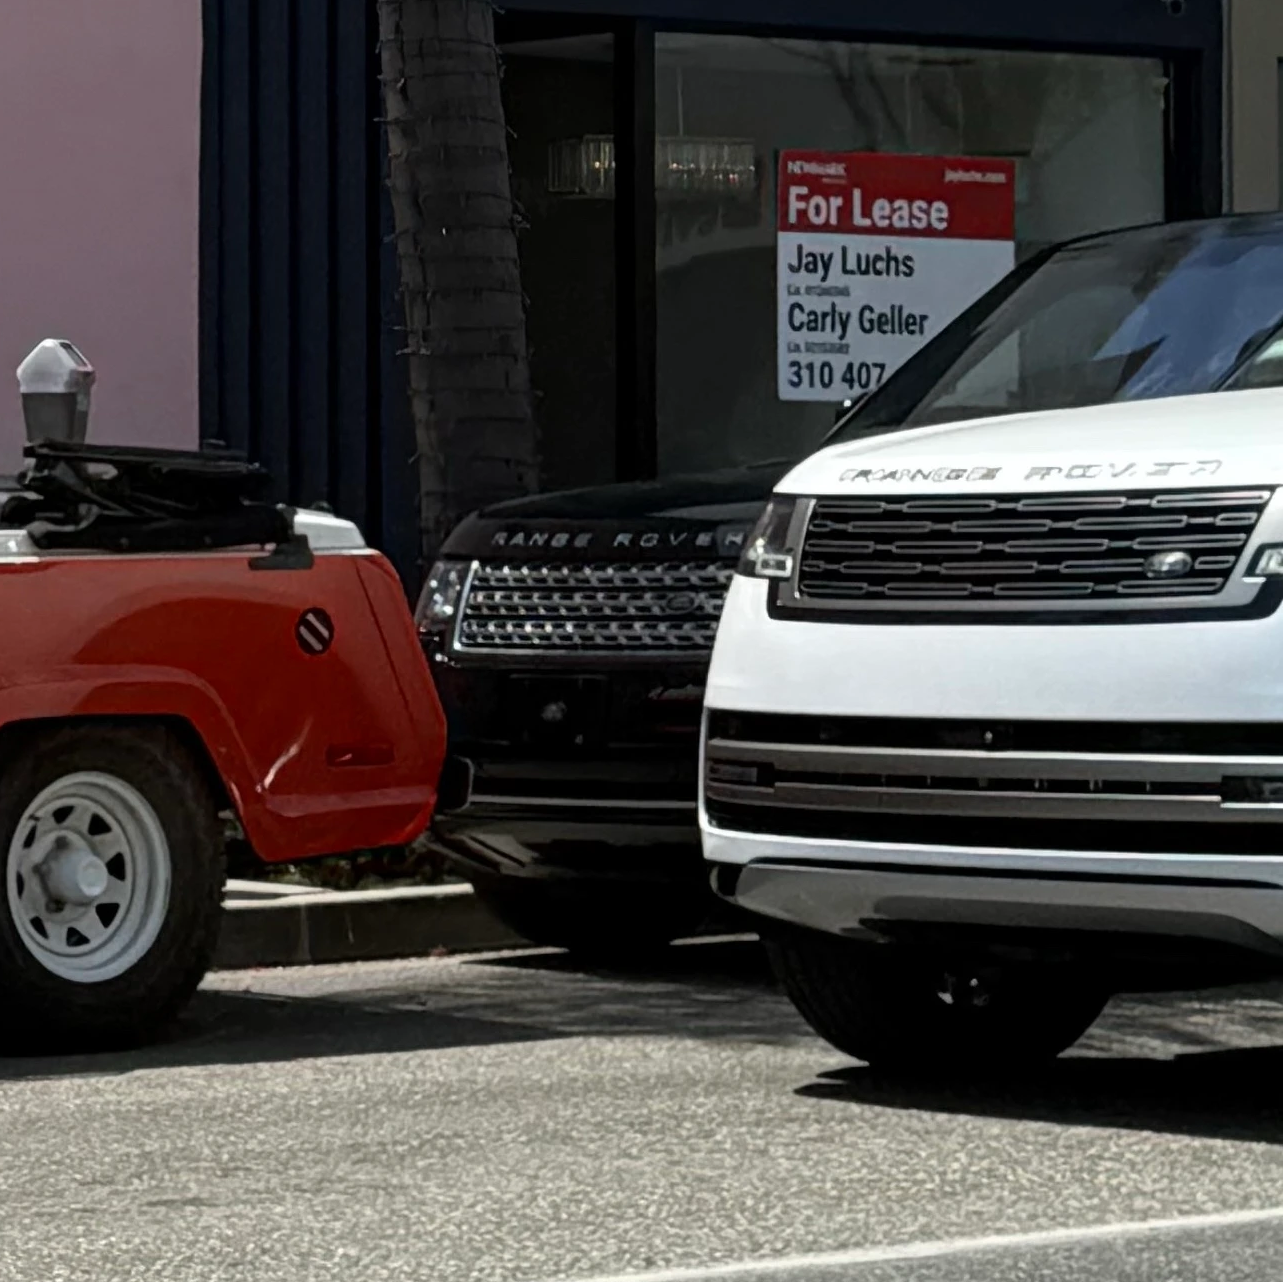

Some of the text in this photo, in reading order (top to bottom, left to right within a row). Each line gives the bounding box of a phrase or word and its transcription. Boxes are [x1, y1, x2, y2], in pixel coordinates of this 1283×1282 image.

[788, 185, 949, 230] For Lease
[787, 244, 915, 282] Jay Luchs
[788, 301, 929, 341] Carly Geller
[788, 361, 886, 390] 310 407
[491, 531, 593, 548] RANGE
